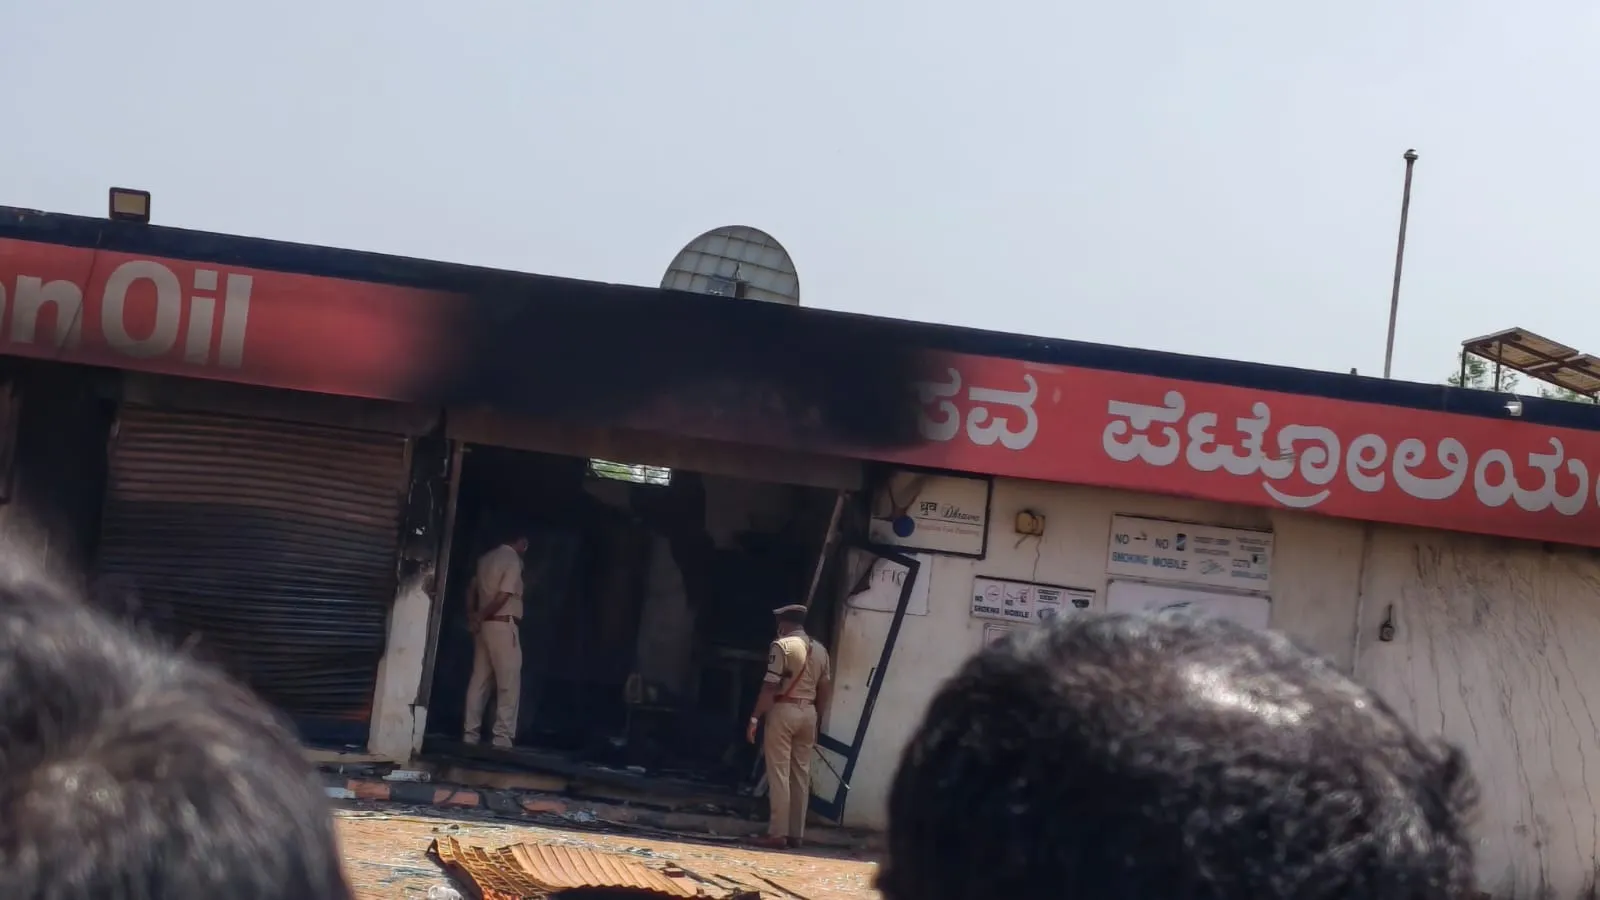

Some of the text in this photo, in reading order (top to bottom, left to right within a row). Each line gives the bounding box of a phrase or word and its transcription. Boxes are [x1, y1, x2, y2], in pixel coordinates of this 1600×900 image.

[1103, 391, 1600, 516] ಪೆಟ್ರೋಲಿಯ
[1115, 533, 1130, 545] NO
[1155, 538, 1169, 550] NO
[1112, 551, 1148, 566] SMOKING
[1152, 556, 1189, 570] MOBILE
